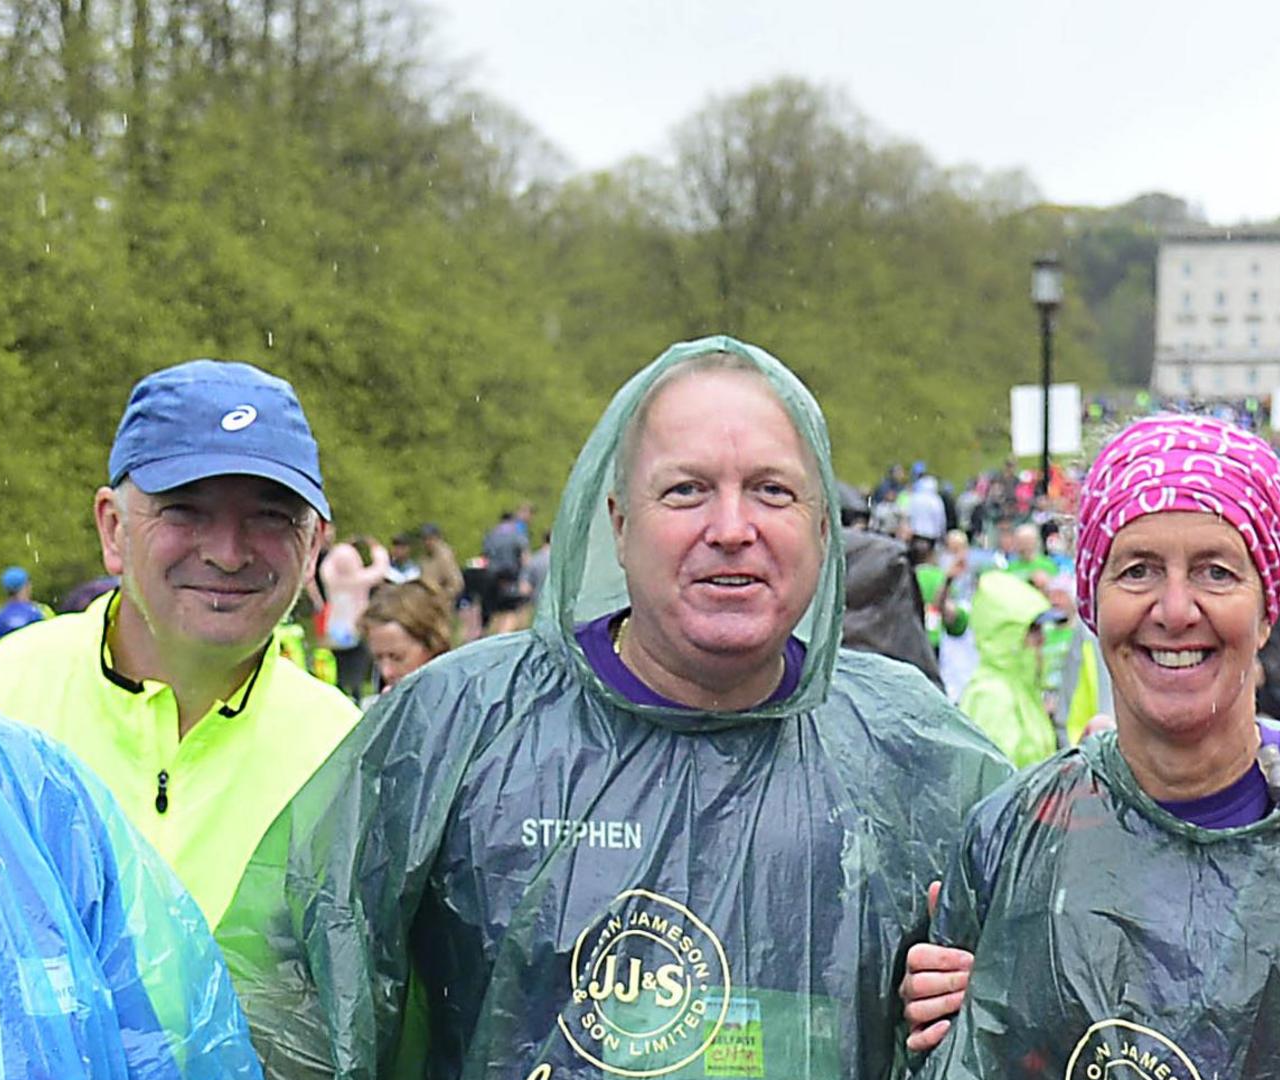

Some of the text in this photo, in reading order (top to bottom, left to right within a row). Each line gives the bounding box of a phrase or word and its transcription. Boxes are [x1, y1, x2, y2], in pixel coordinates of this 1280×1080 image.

[630, 912, 710, 981] JAMESON
[589, 954, 685, 1009] JJ&S
[581, 1010, 620, 1051] SON
[629, 999, 707, 1056] LIMITED
